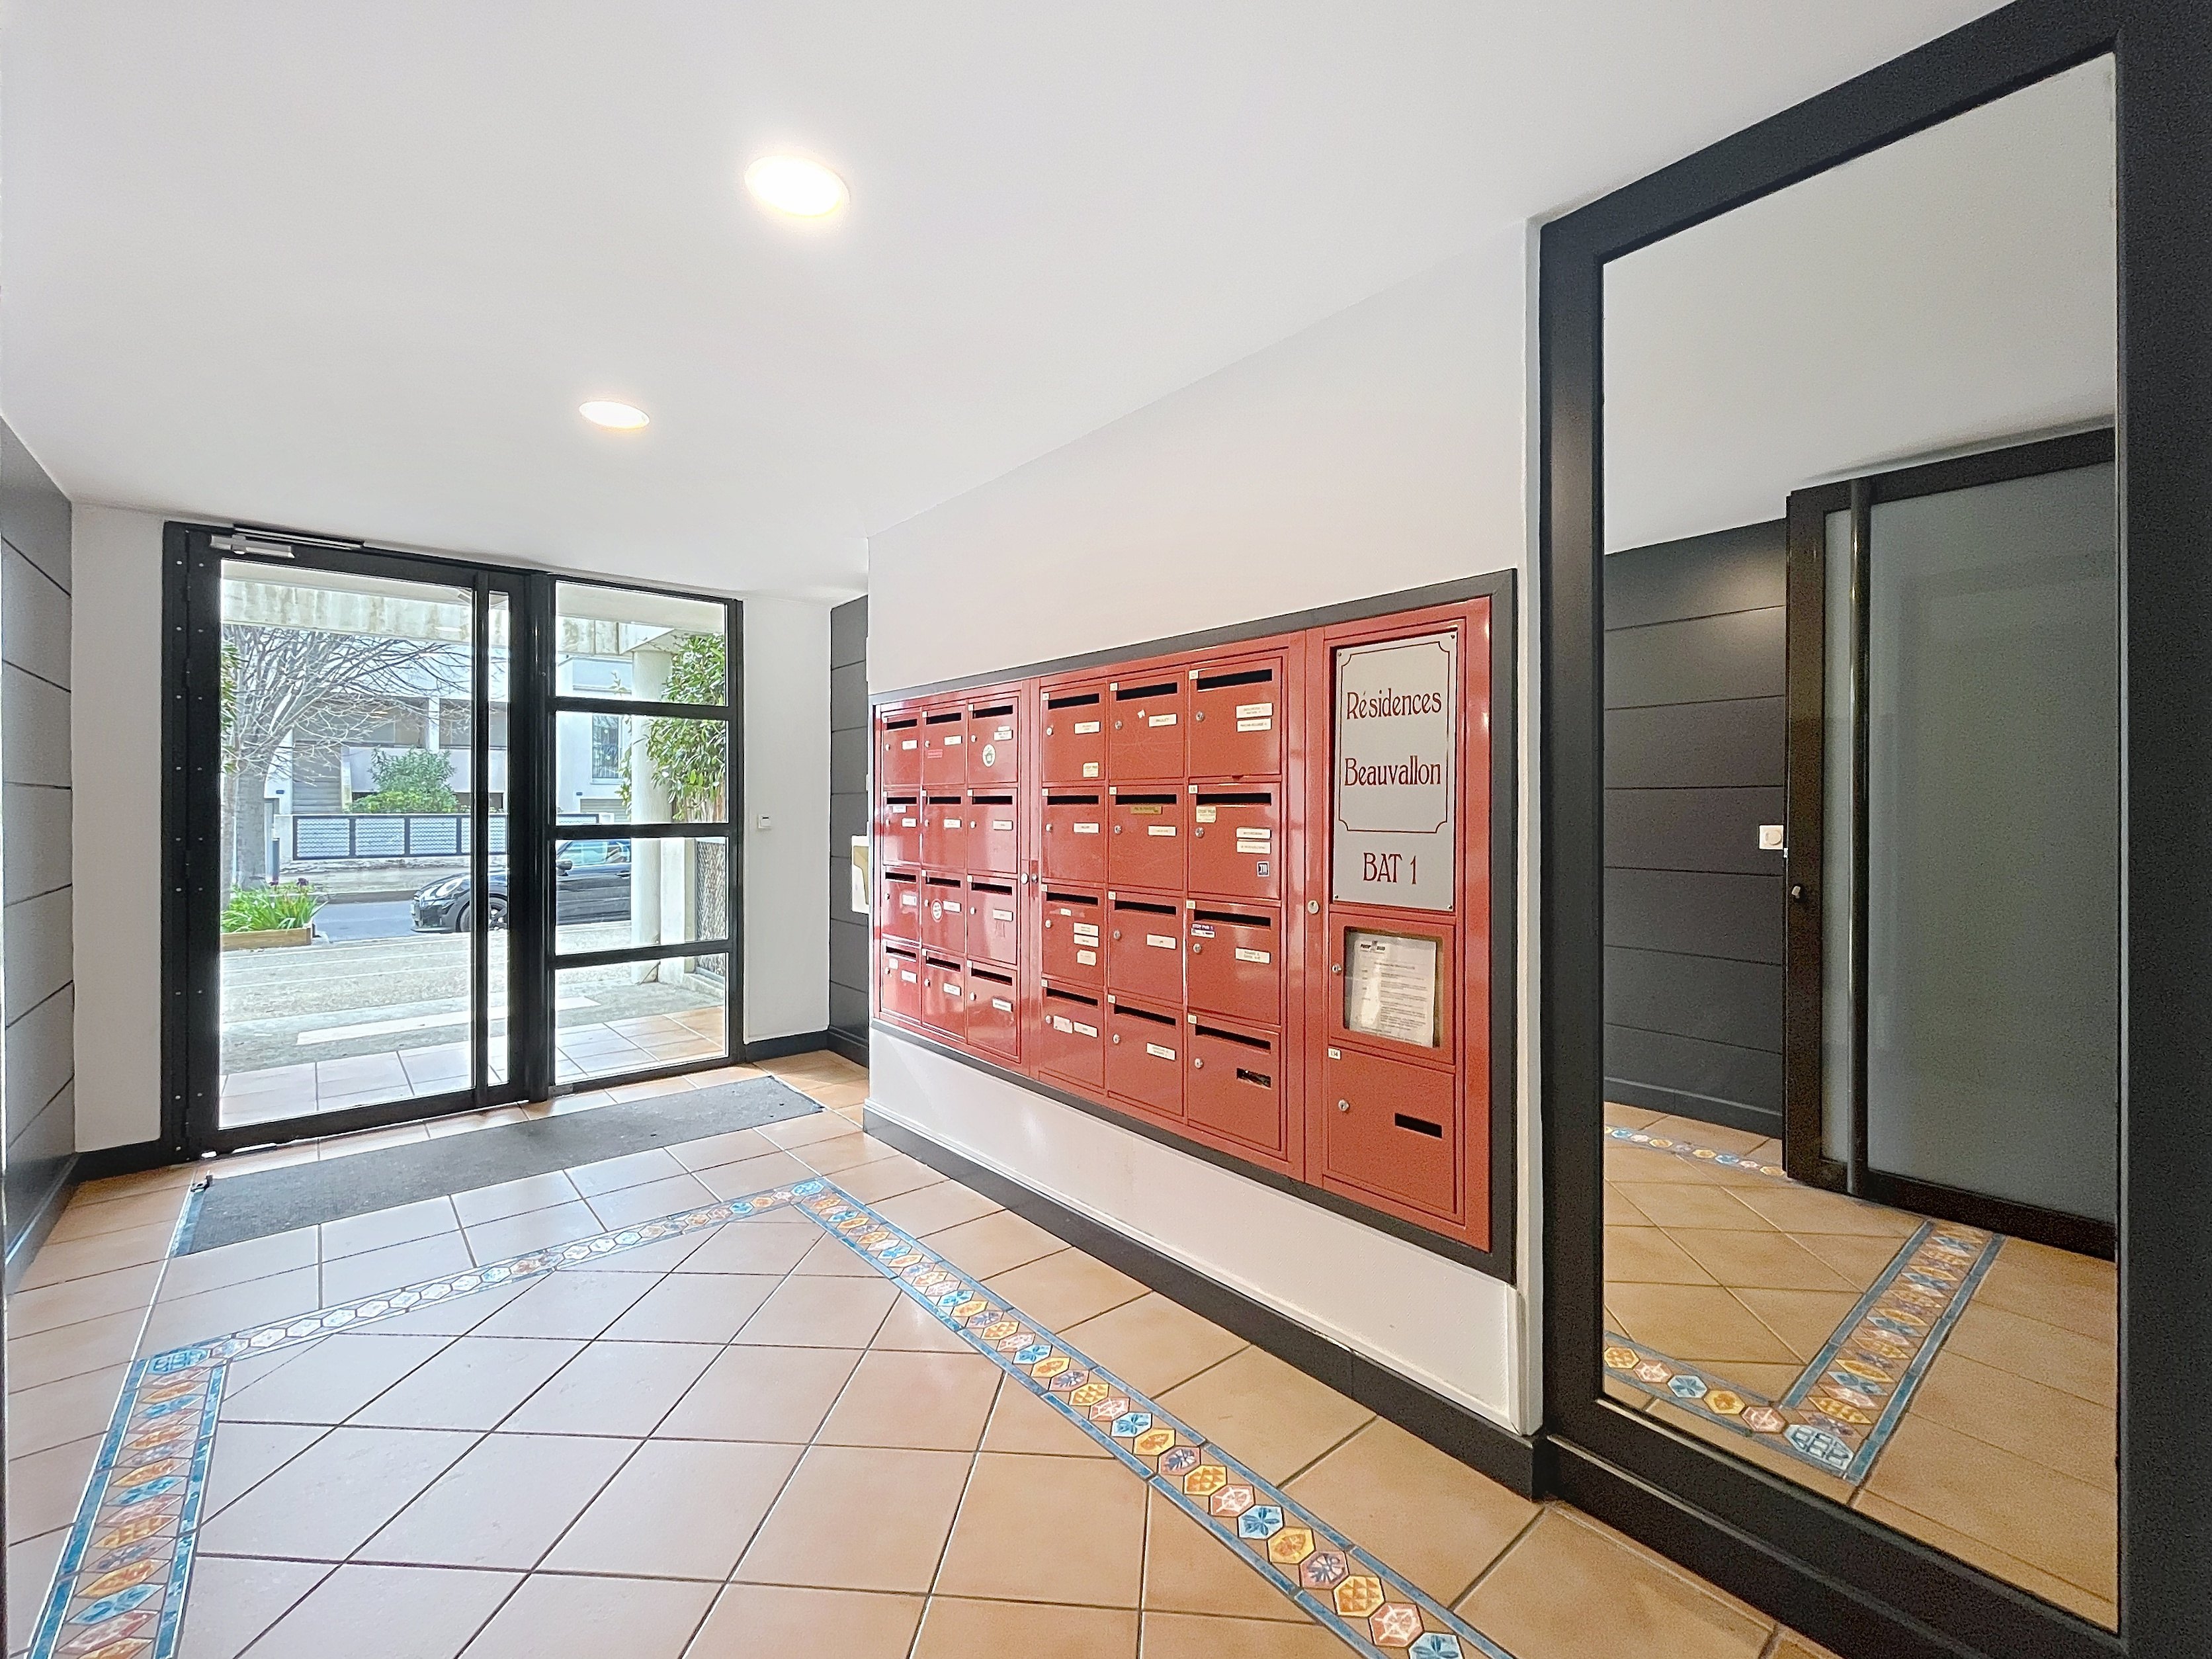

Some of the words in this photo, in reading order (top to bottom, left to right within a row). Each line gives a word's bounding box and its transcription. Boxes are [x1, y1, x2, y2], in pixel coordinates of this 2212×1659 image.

[1346, 688, 1442, 720] Résidences
[1344, 755, 1441, 786] Beauvallon
[1363, 852, 1403, 883] BAT
[1410, 855, 1417, 885] 1
